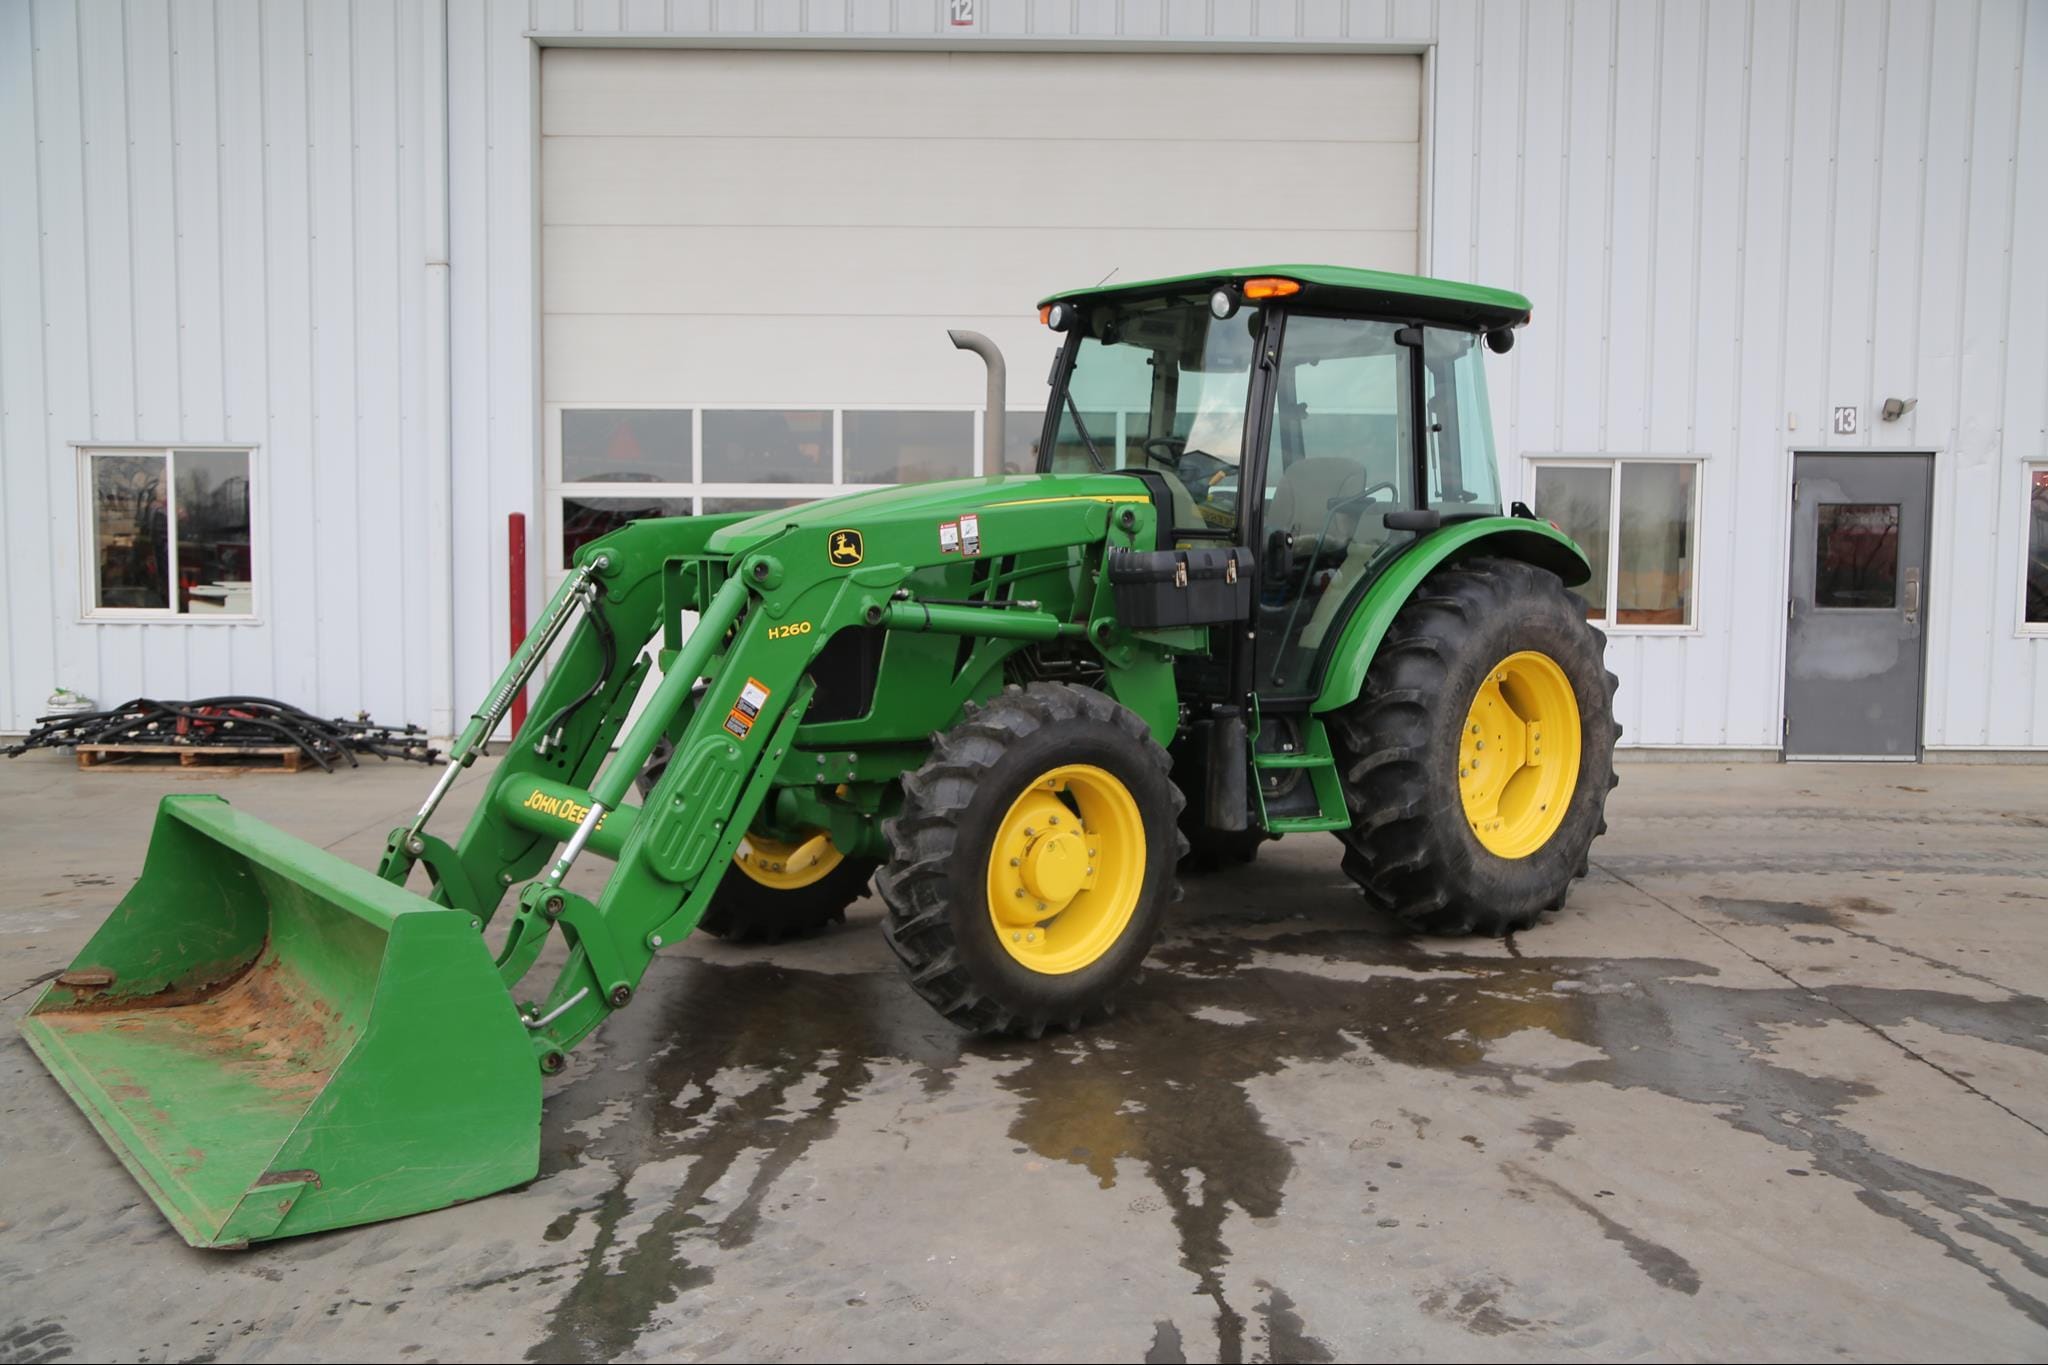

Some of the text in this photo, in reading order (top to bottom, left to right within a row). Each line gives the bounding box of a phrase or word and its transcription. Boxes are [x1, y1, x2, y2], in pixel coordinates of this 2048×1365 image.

[951, 0, 972, 20] 12
[1835, 408, 1856, 431] 13
[768, 621, 811, 640] H260
[524, 789, 608, 832] JOHN DEE
